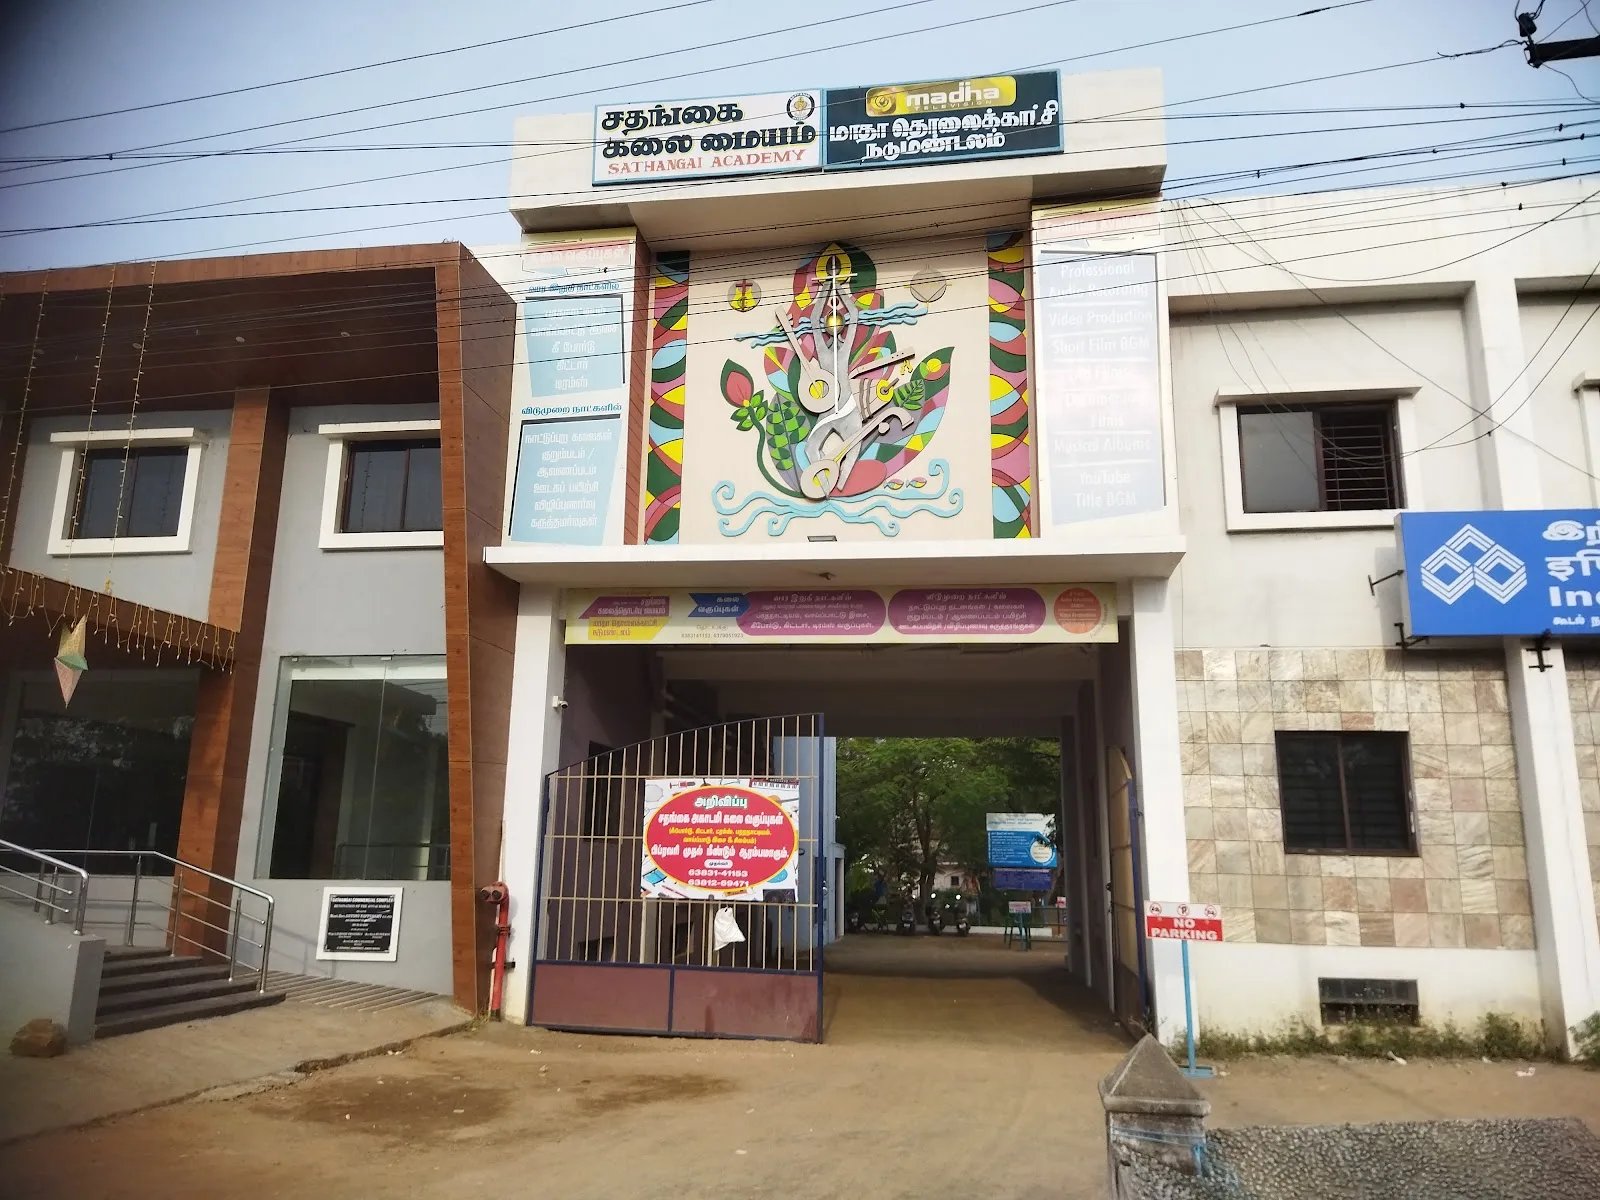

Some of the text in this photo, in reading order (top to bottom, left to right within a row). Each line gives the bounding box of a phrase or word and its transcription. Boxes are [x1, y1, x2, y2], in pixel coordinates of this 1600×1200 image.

[906, 82, 1000, 107] madha
[601, 104, 743, 136] சதங்கை
[830, 99, 1059, 144] மாதா தொலைக்காட்சி
[602, 121, 816, 158] கலை மையம்
[862, 127, 1006, 162] நடுமண்டலம்
[608, 149, 807, 175] SATHANGAI ACADEMY
[1061, 260, 1134, 279] Professional
[1048, 309, 1153, 327] Video Production
[1052, 336, 1150, 354] Short Film BGM
[521, 403, 622, 416] விடுமுறை நாட்களில்
[1080, 470, 1131, 485] YouTube
[1074, 492, 1136, 509] Title BGM
[698, 605, 740, 614] வகுப்புகள்
[694, 795, 748, 809] அறிவிப்பு
[1173, 917, 1196, 929] NO
[1150, 927, 1218, 940] PARKING
